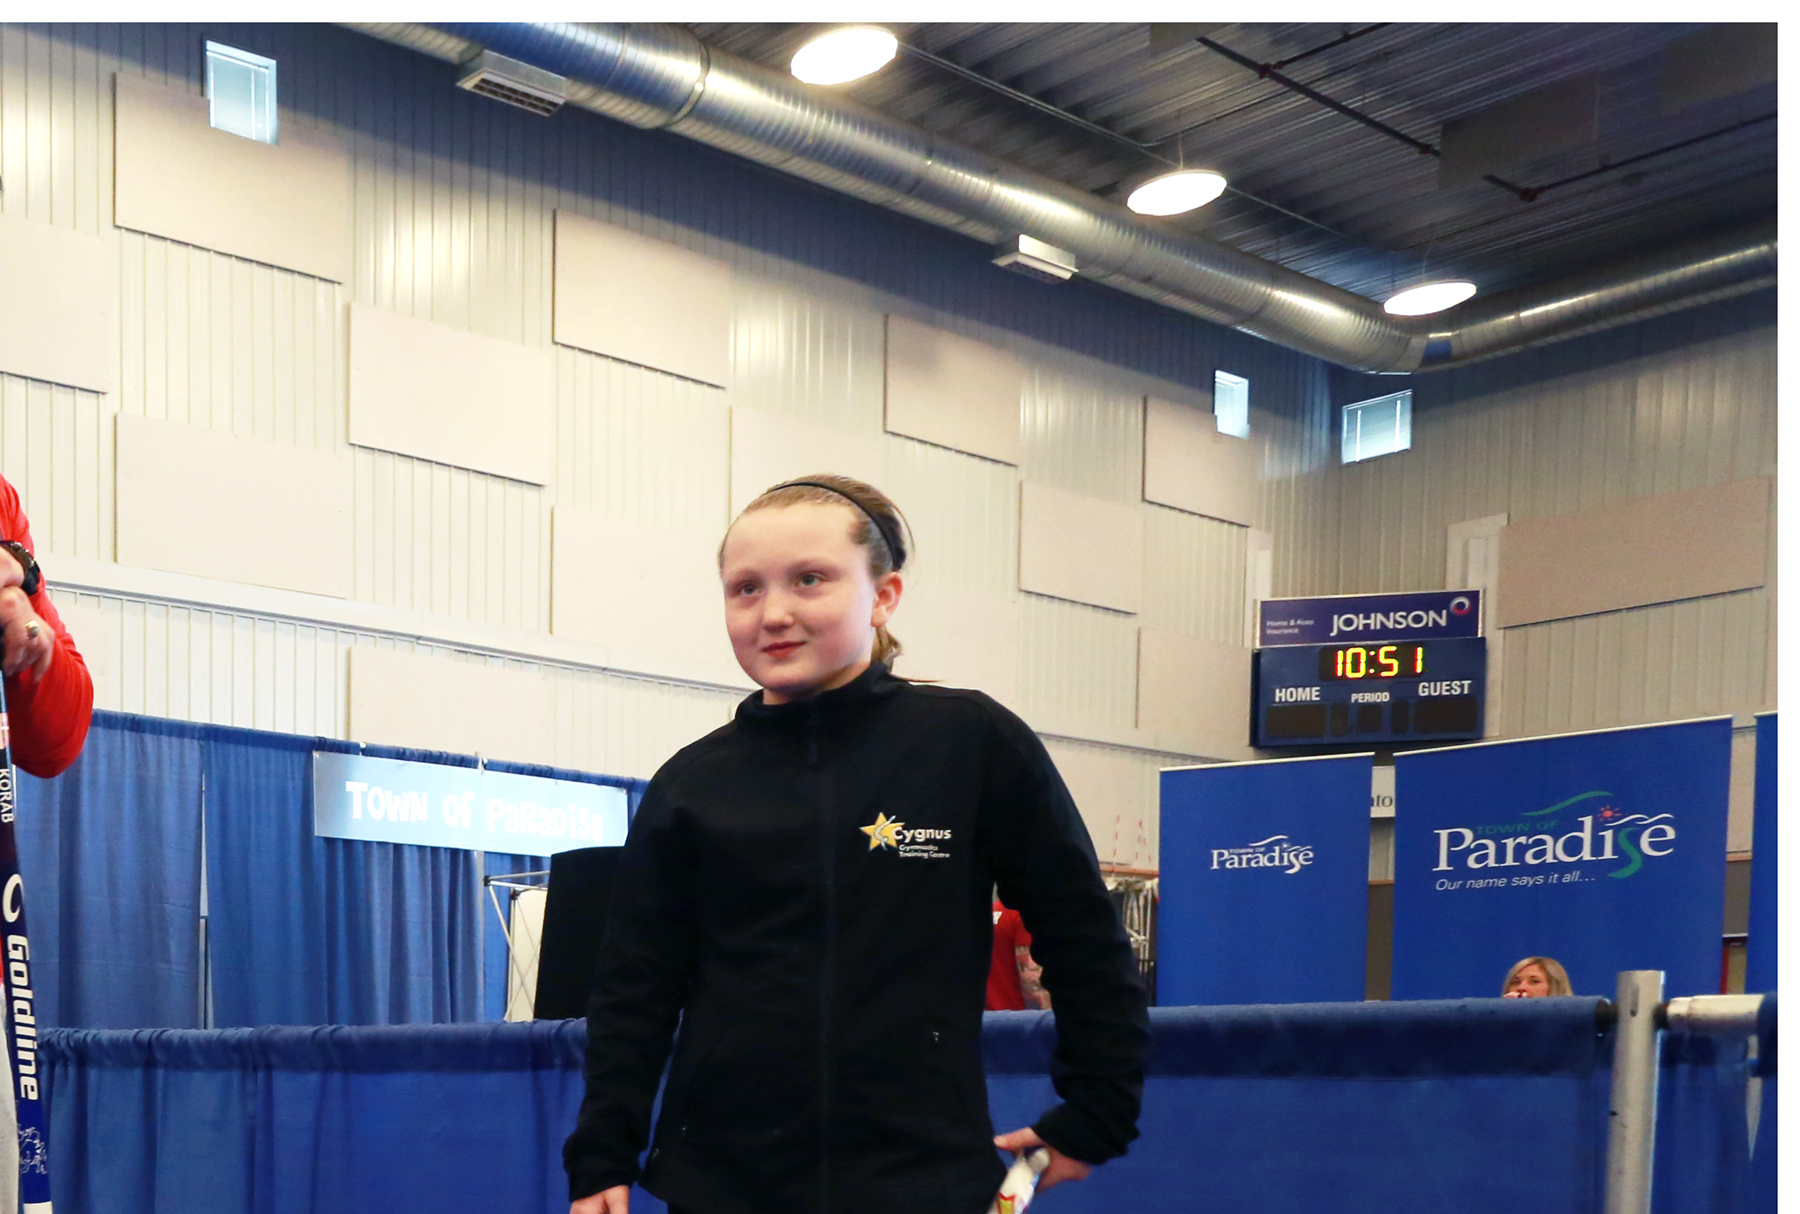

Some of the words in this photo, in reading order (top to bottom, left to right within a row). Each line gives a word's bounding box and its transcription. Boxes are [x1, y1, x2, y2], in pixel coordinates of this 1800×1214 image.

[1330, 610, 1447, 636] JOHNSON
[1335, 645, 1423, 679] 10:51
[1275, 687, 1321, 702] HOME
[1351, 692, 1390, 703] PERIOD
[1418, 680, 1472, 697] GUEST
[892, 826, 952, 843] Cygnus
[1476, 822, 1529, 836] TOWN
[1537, 819, 1559, 831] OF
[1432, 815, 1676, 879] Paradise
[1210, 845, 1314, 875] Paradise
[1435, 878, 1461, 891] Our
[1466, 877, 1507, 890] name
[1511, 874, 1544, 888] says
[1548, 872, 1557, 884] it
[7, 933, 39, 1100] Goldline
